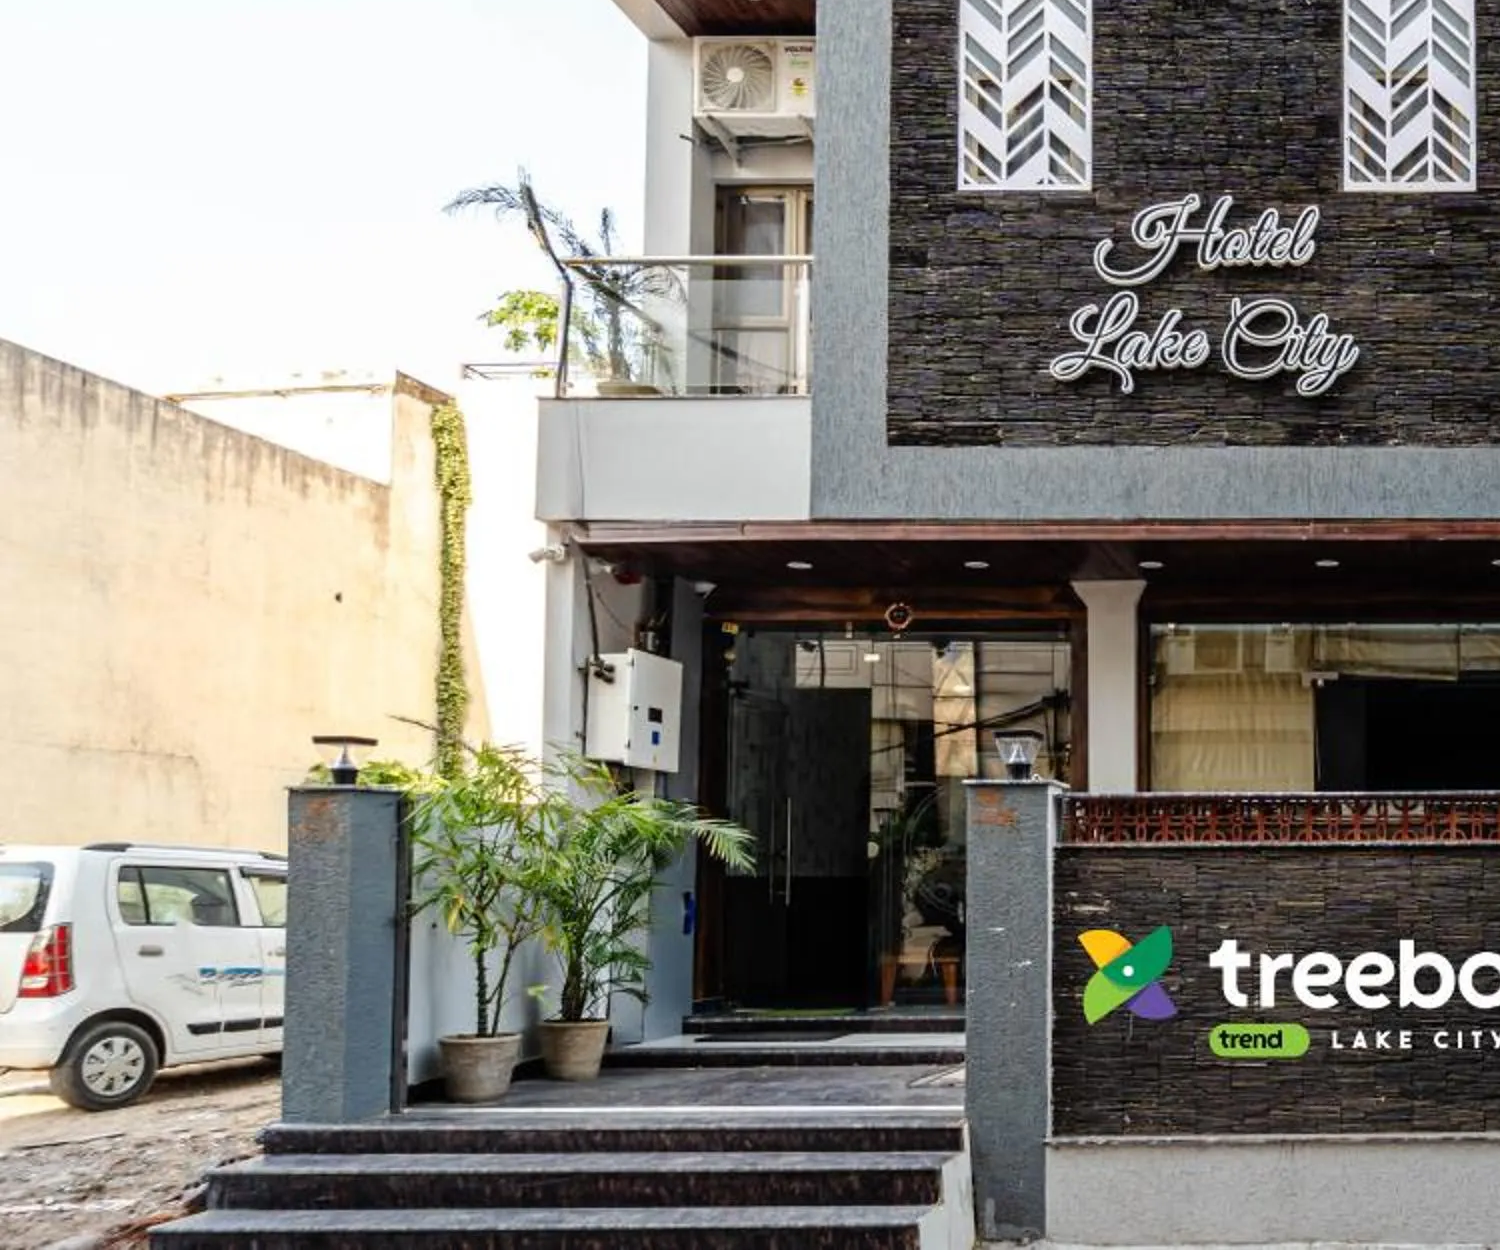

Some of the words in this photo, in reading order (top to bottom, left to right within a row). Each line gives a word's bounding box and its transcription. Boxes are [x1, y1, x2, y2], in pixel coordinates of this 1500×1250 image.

[1094, 192, 1322, 286] Hotel
[1049, 290, 1211, 395] Lake
[1221, 297, 1360, 397] City
[1218, 1029, 1284, 1049] trend
[1331, 1030, 1413, 1049] LAKE
